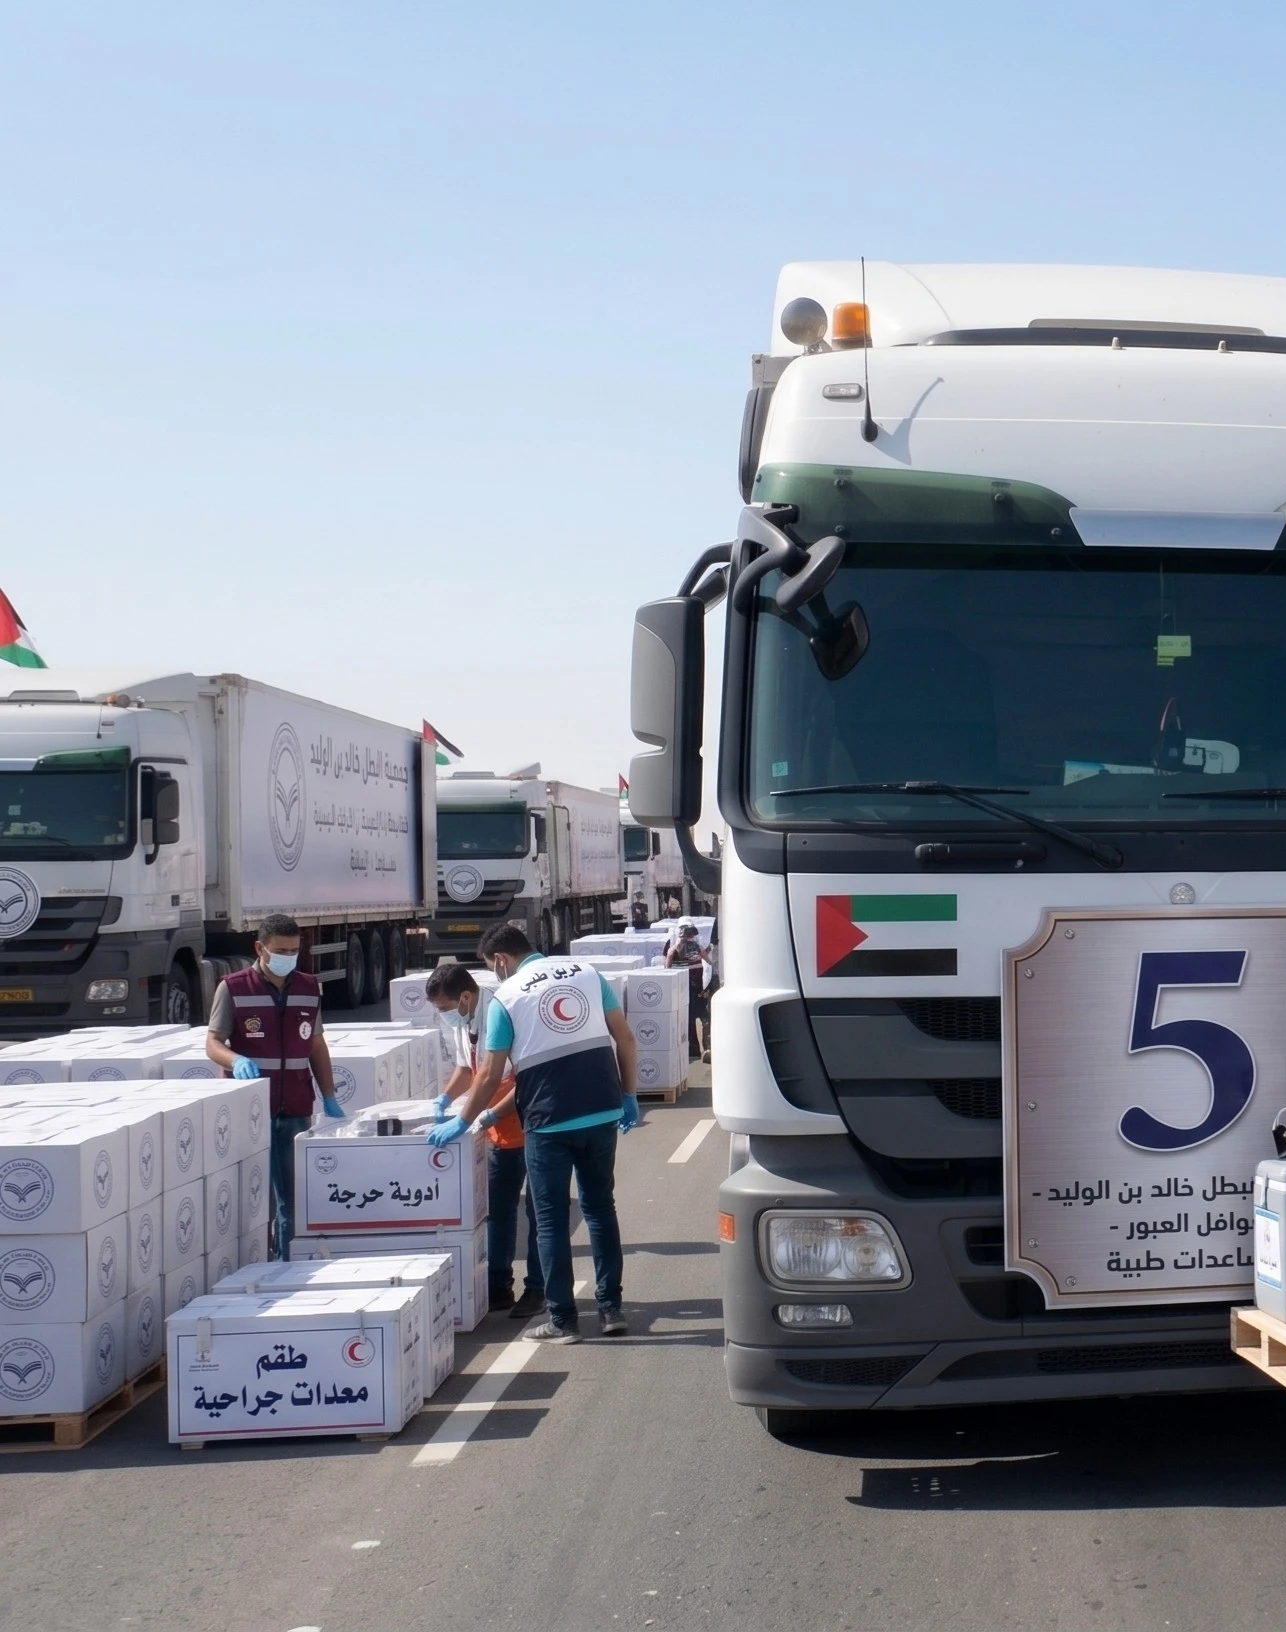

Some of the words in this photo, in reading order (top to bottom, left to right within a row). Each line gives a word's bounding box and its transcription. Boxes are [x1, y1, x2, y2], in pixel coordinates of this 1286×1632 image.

[1118, 950, 1257, 1152] 5
[327, 1183, 385, 1209] حرجة
[389, 1177, 440, 1207] أدوية
[1047, 1179, 1110, 1206] الوليد
[1118, 1182, 1142, 1204] بن
[1150, 1177, 1194, 1198] خالد
[1202, 1175, 1255, 1202] لبطل
[1126, 1212, 1189, 1240] العبور
[1196, 1211, 1254, 1237] وافل
[1106, 1251, 1165, 1279] طبية
[1173, 1247, 1255, 1269] اعدات
[256, 1344, 308, 1379] طقم
[193, 1384, 284, 1419] جراحية
[290, 1381, 369, 1407] معدات
